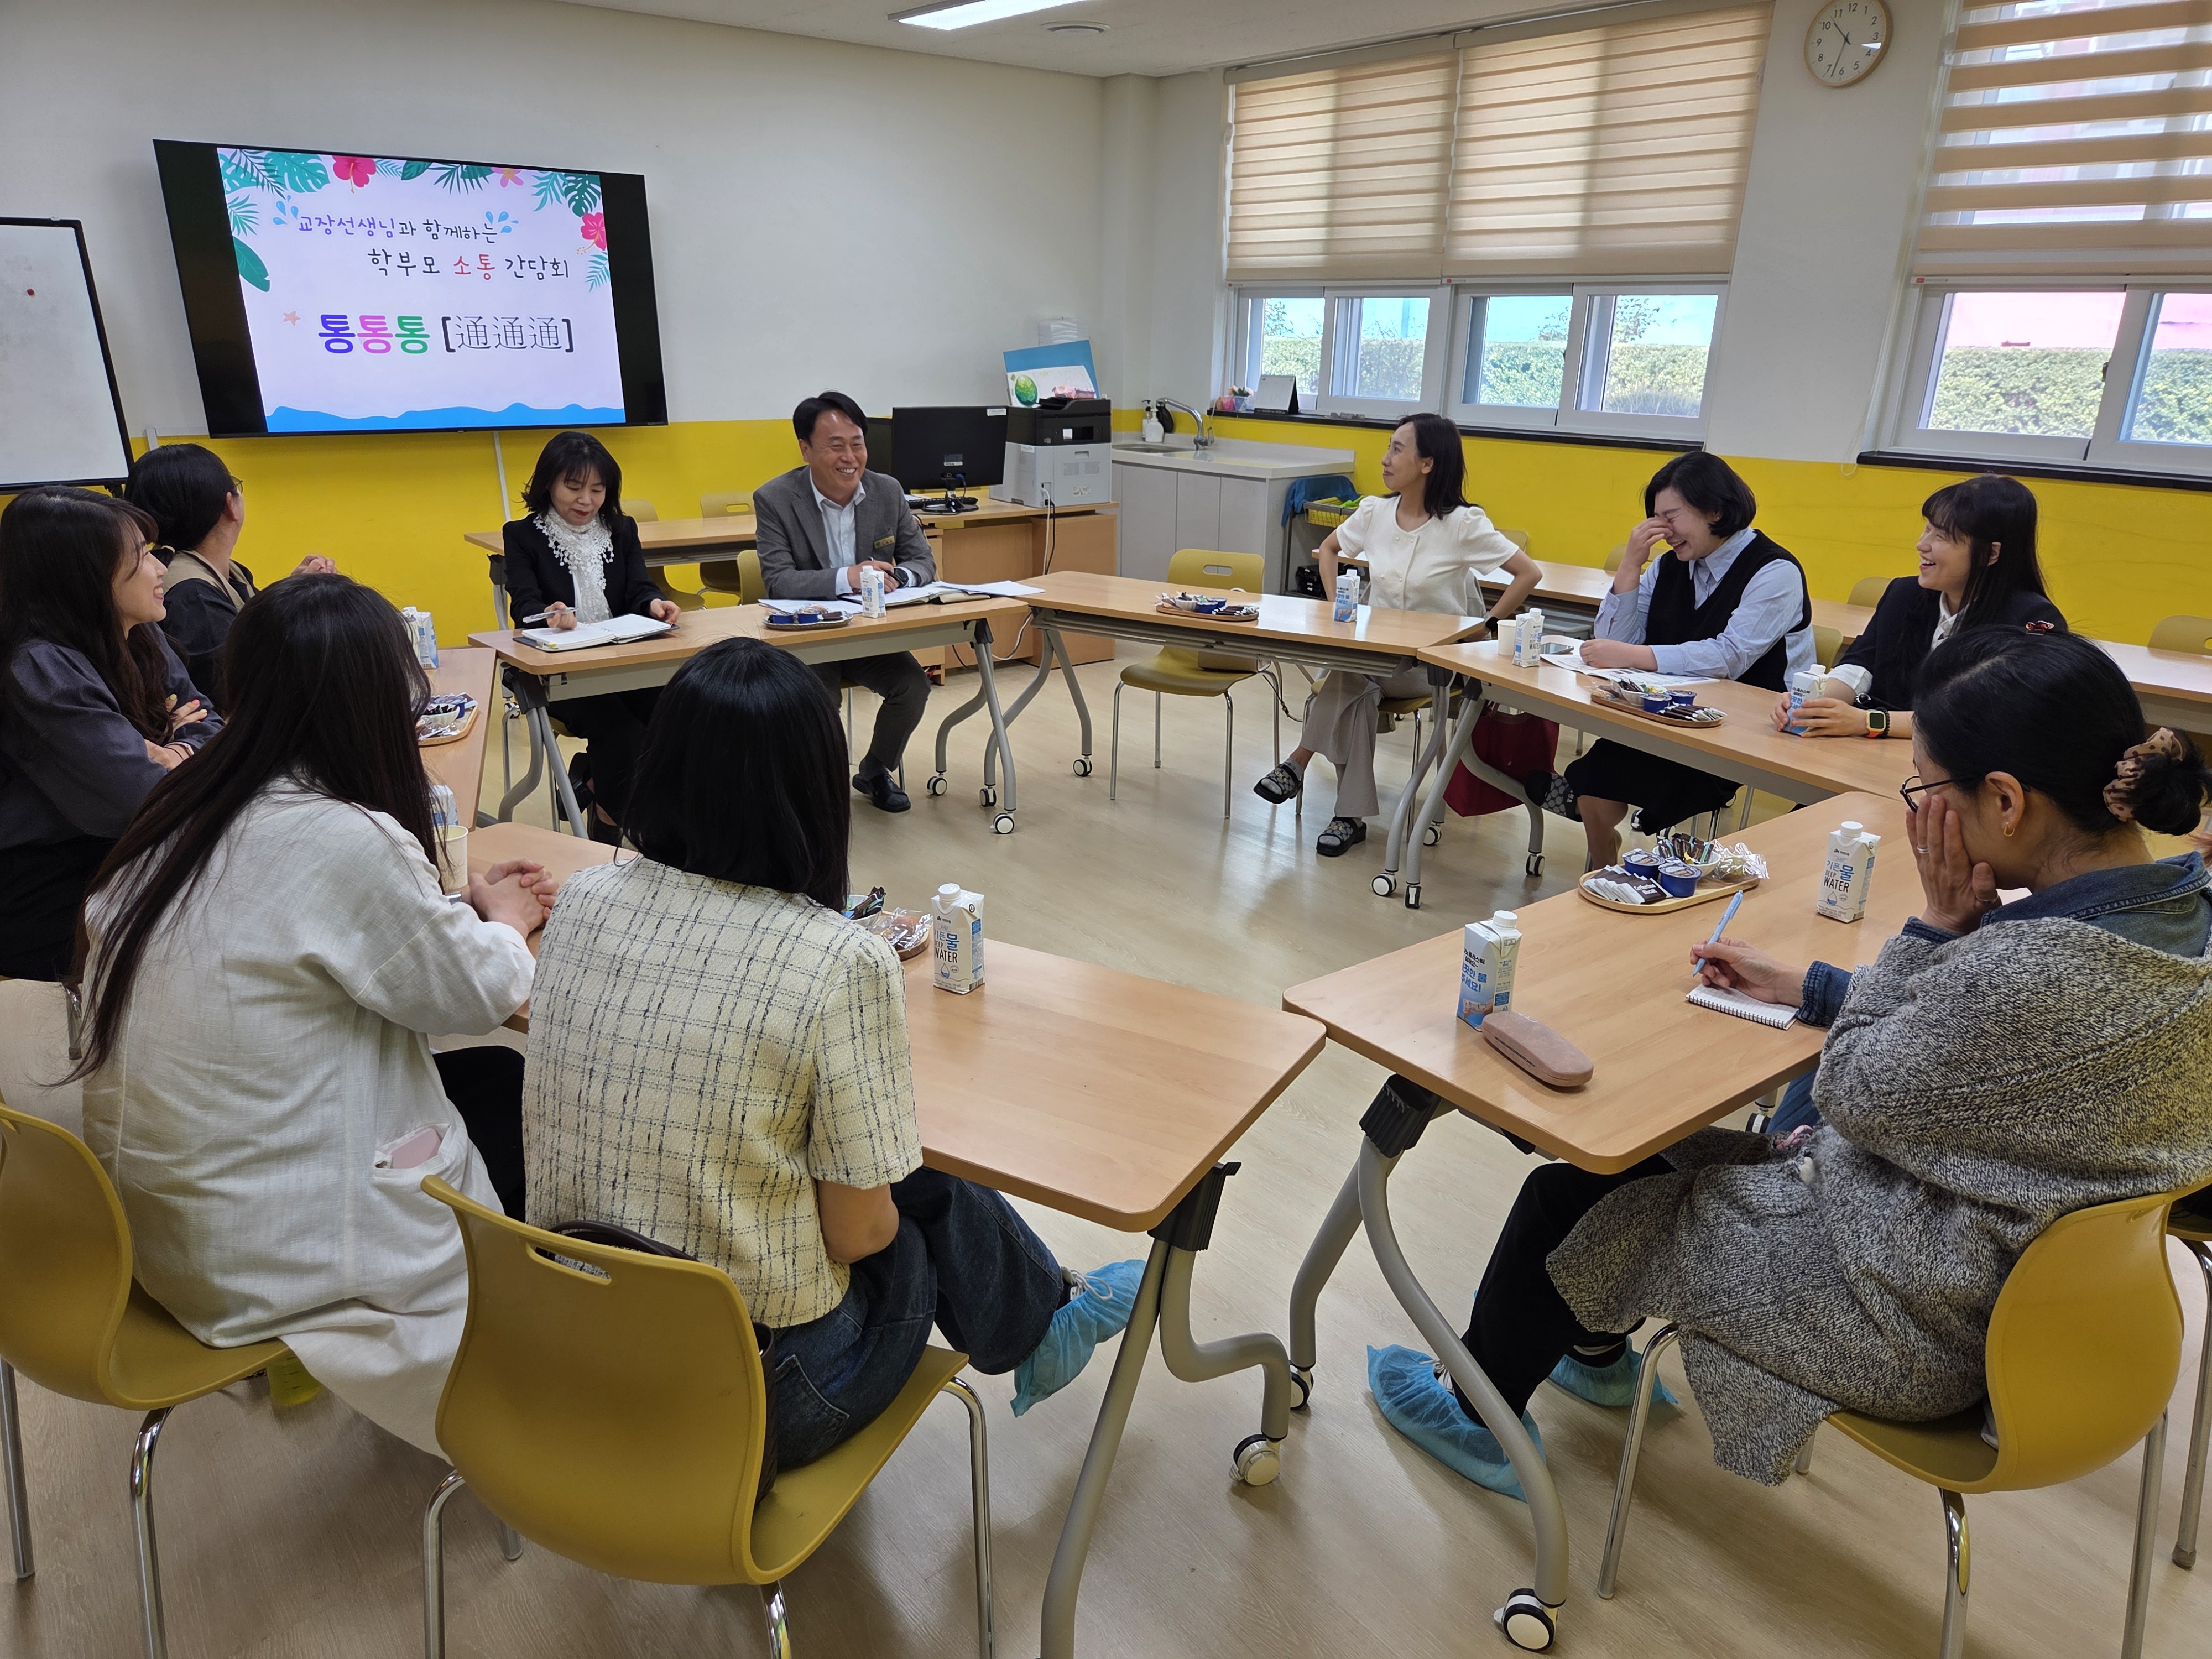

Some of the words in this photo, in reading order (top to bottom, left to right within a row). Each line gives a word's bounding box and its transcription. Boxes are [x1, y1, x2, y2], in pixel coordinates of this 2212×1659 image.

[1849, 3, 1858, 12] 12
[1864, 6, 1868, 14] 1
[1834, 9, 1843, 18] 11
[1871, 16, 1877, 25] 2
[1822, 22, 1831, 30] 10
[1873, 32, 1879, 40] 3
[1817, 38, 1822, 46] 9
[1818, 54, 1823, 62] 8
[1826, 64, 1832, 73] 7
[1854, 61, 1859, 70] 5
[1839, 67, 1844, 75] 6
[299, 214, 416, 238] 교장선생님과
[422, 218, 498, 243] 함께하는
[367, 248, 441, 276] 학부모
[453, 254, 495, 280] 소통
[505, 254, 568, 280] 간담회
[318, 314, 430, 354] 통통통
[441, 315, 574, 353] [通通通]
[1824, 876, 1850, 893] WATER
